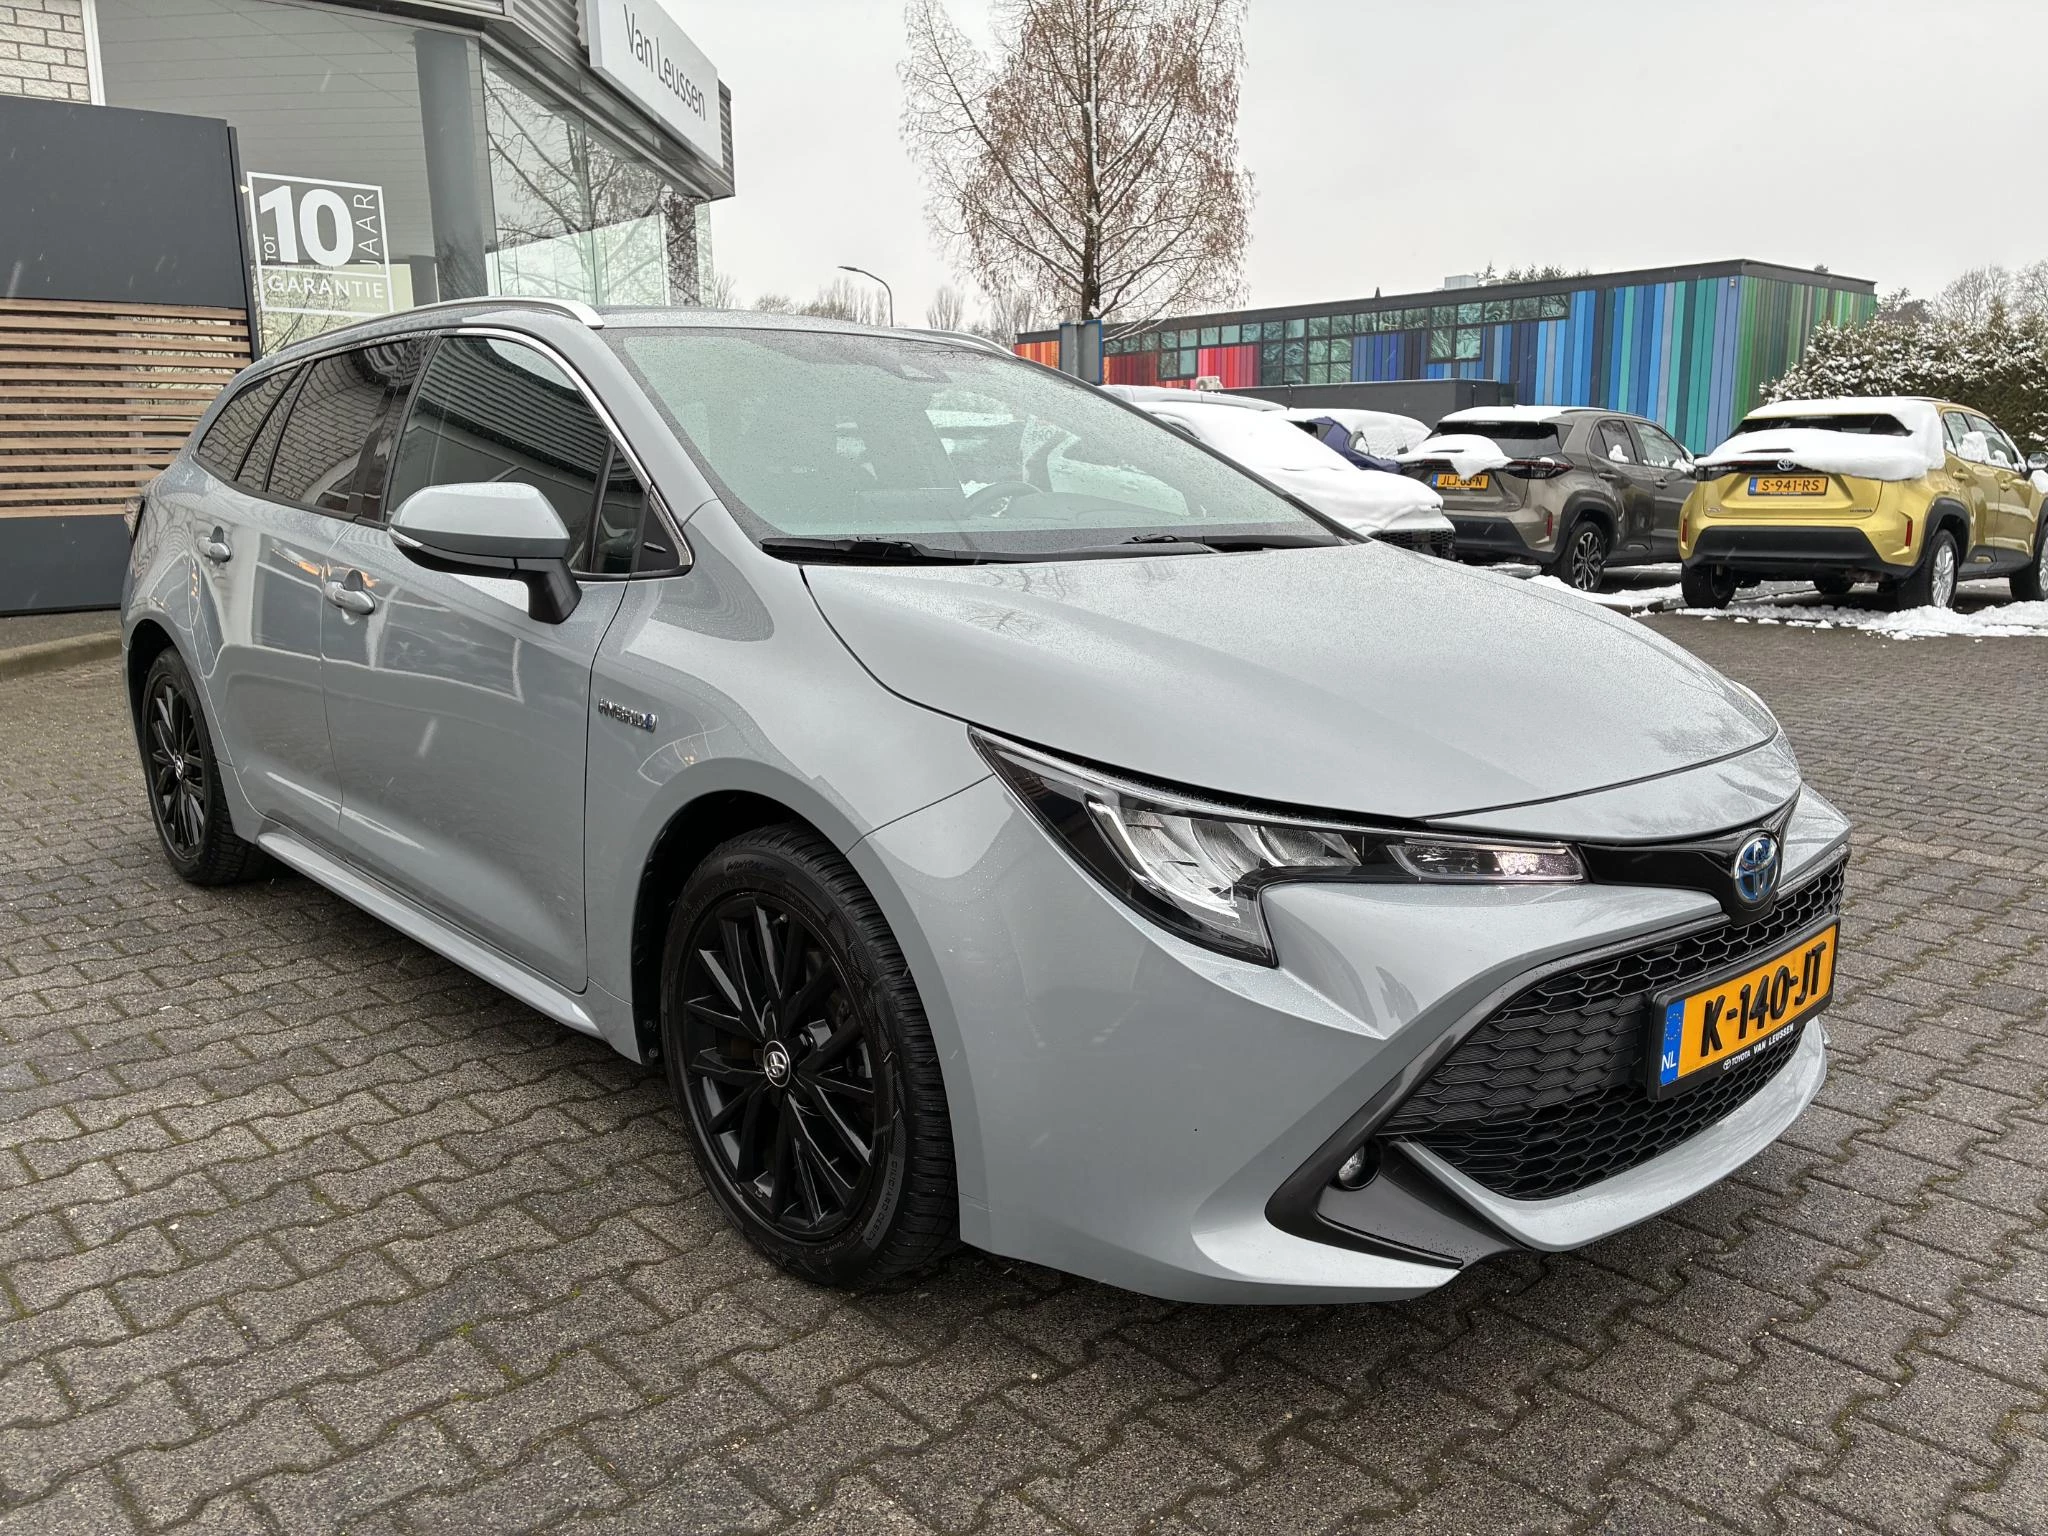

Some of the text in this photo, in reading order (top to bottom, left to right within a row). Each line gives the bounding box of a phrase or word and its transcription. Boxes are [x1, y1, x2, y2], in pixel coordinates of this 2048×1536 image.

[623, 3, 706, 121] Van Leussen
[258, 185, 381, 270] TOT 10 JAAR
[267, 275, 384, 299] GARANTIE
[1761, 480, 1820, 491] S-941-RS
[1700, 941, 1827, 1057] K-140-JT
[1661, 1051, 1677, 1072] NL
[1731, 1022, 1794, 1066] TOYOTA VAN LEUSSEN
